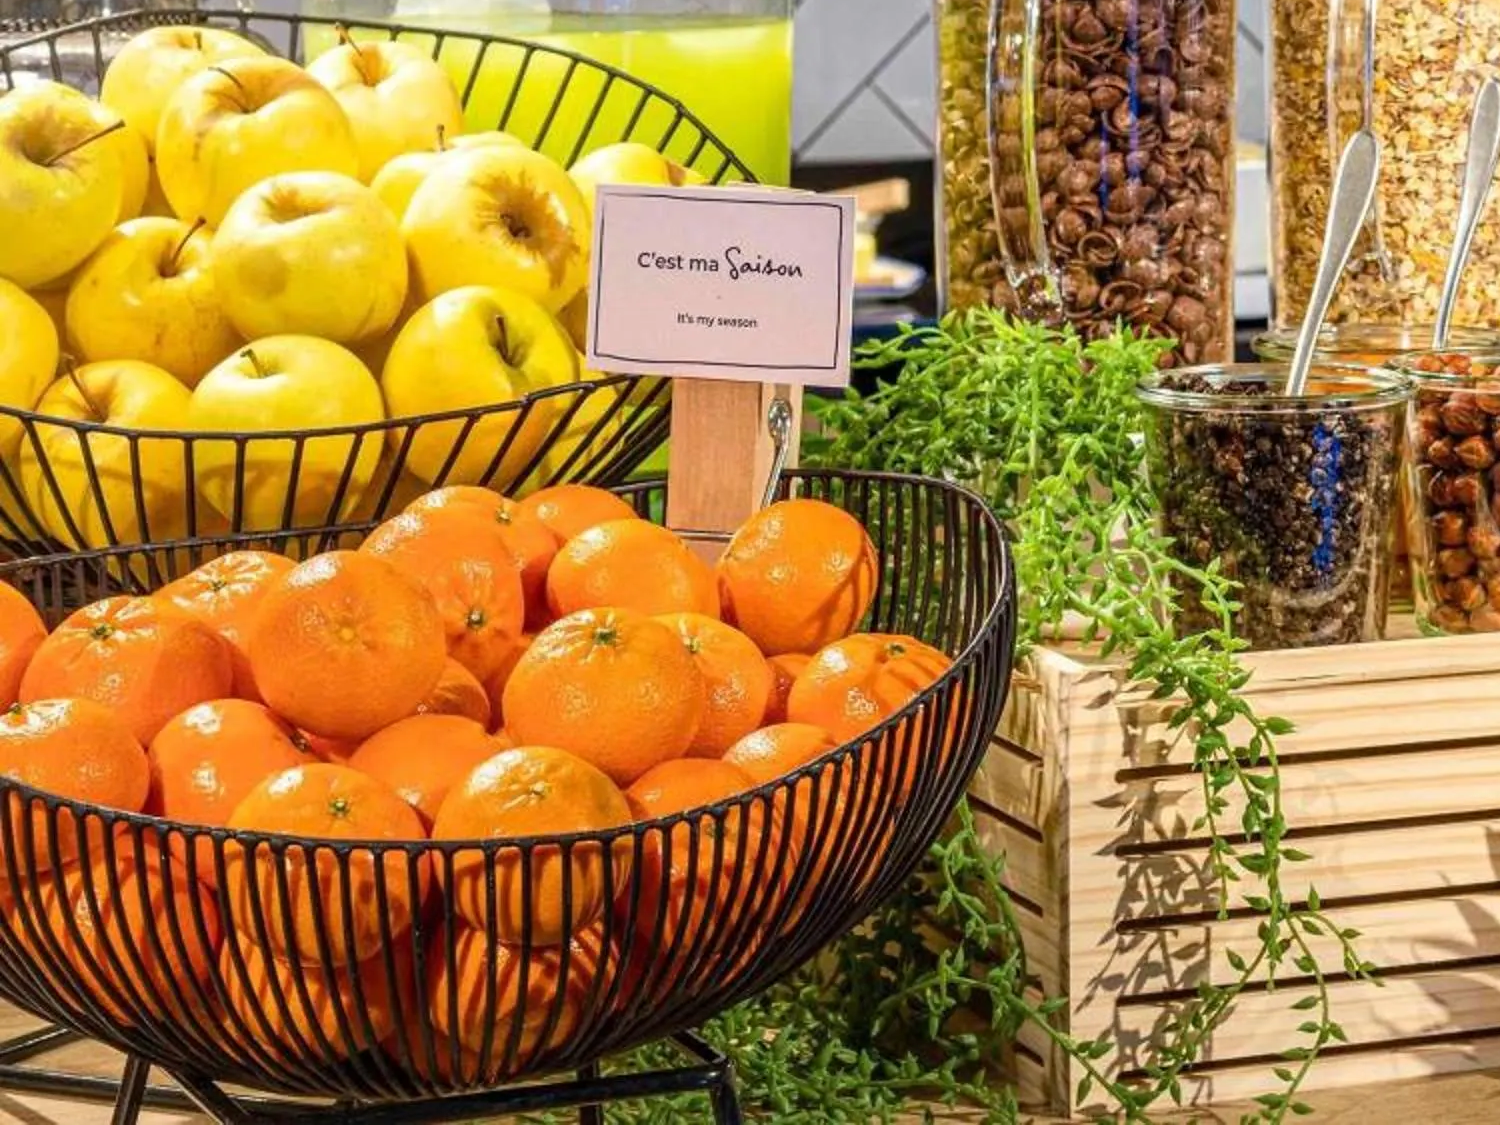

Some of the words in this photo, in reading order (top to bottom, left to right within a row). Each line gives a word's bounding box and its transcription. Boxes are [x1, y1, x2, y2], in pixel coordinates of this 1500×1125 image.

[637, 251, 684, 271] C'est
[689, 257, 719, 272] ma
[724, 246, 803, 279] Saison
[677, 312, 694, 324] It's
[696, 316, 715, 328] my
[717, 317, 758, 328] season
